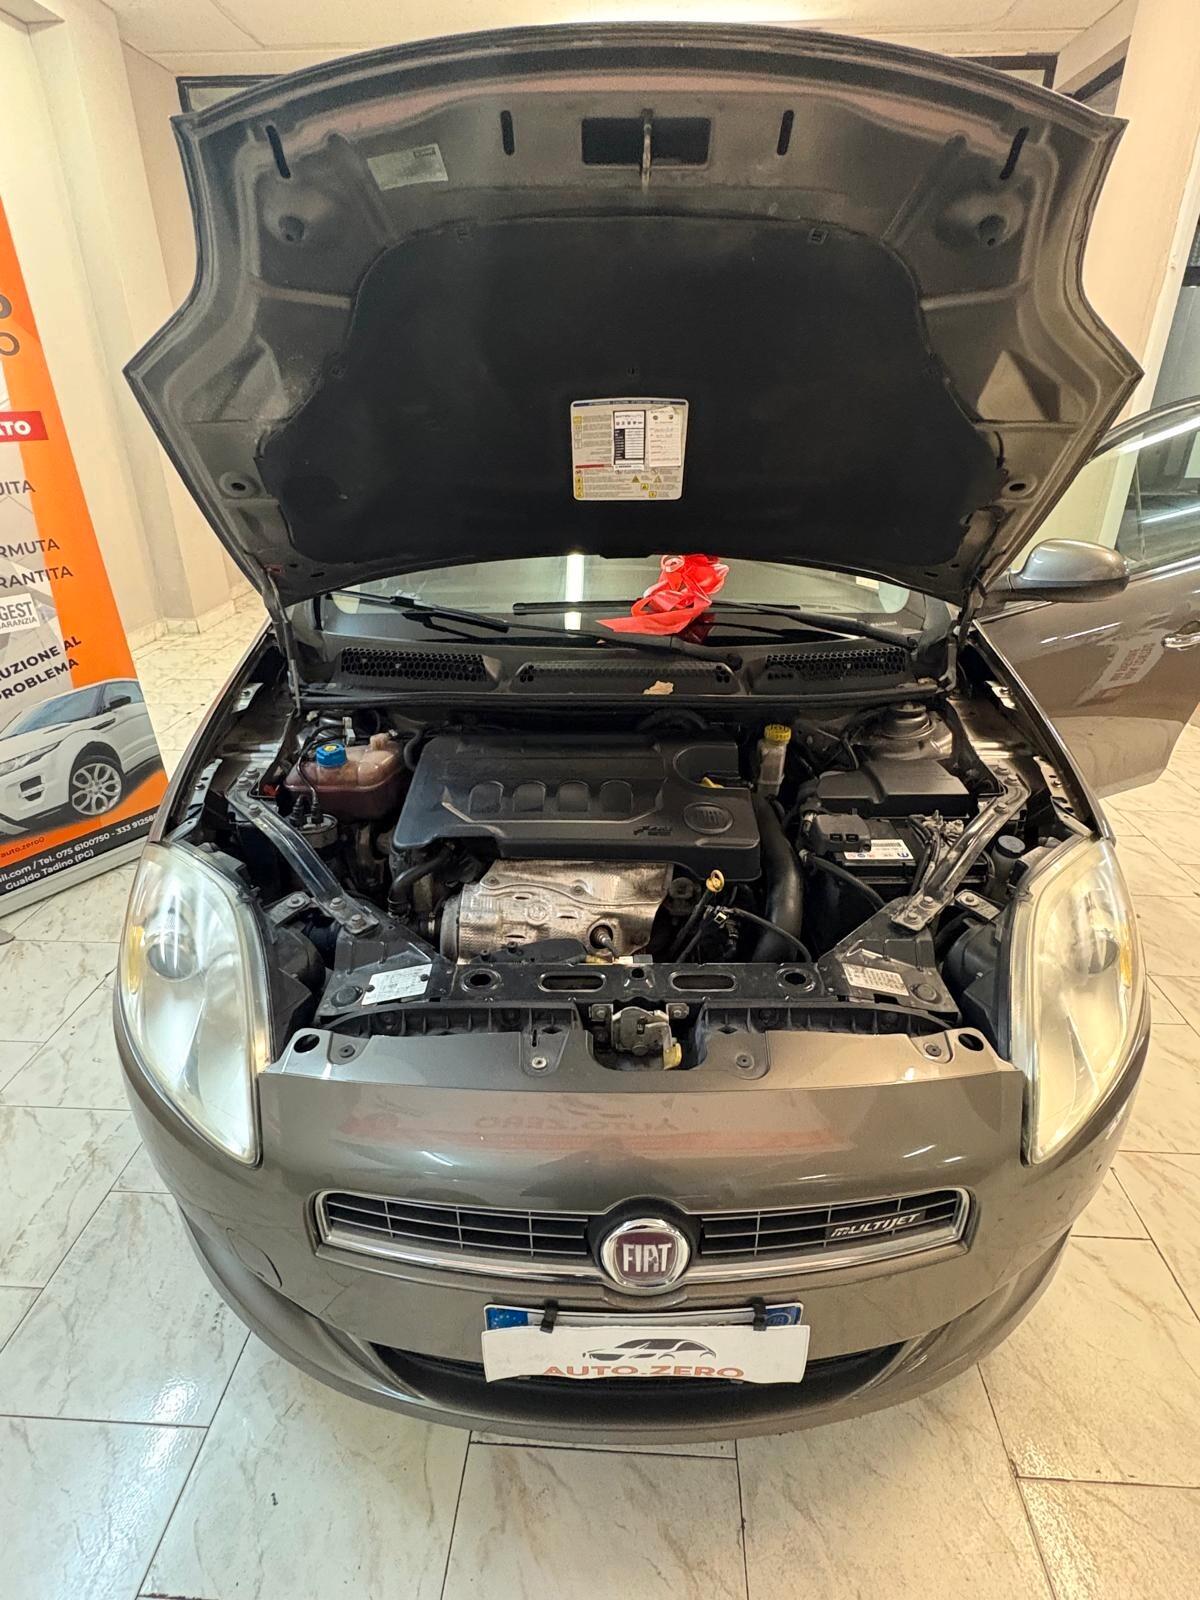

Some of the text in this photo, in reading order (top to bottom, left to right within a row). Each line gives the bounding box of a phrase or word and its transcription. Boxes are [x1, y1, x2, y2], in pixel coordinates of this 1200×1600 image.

[0, 636, 82, 680] UZIONE AL
[0, 658, 79, 699] ROBLEMA
[38, 855, 56, 866] Tel.
[56, 847, 74, 859] 075
[74, 832, 110, 852] 6100750
[115, 824, 132, 835] 333
[5, 849, 95, 890] Gualdo Tadino (PG)
[831, 1212, 921, 1238] MULTIJET
[622, 1243, 673, 1273] FIAT
